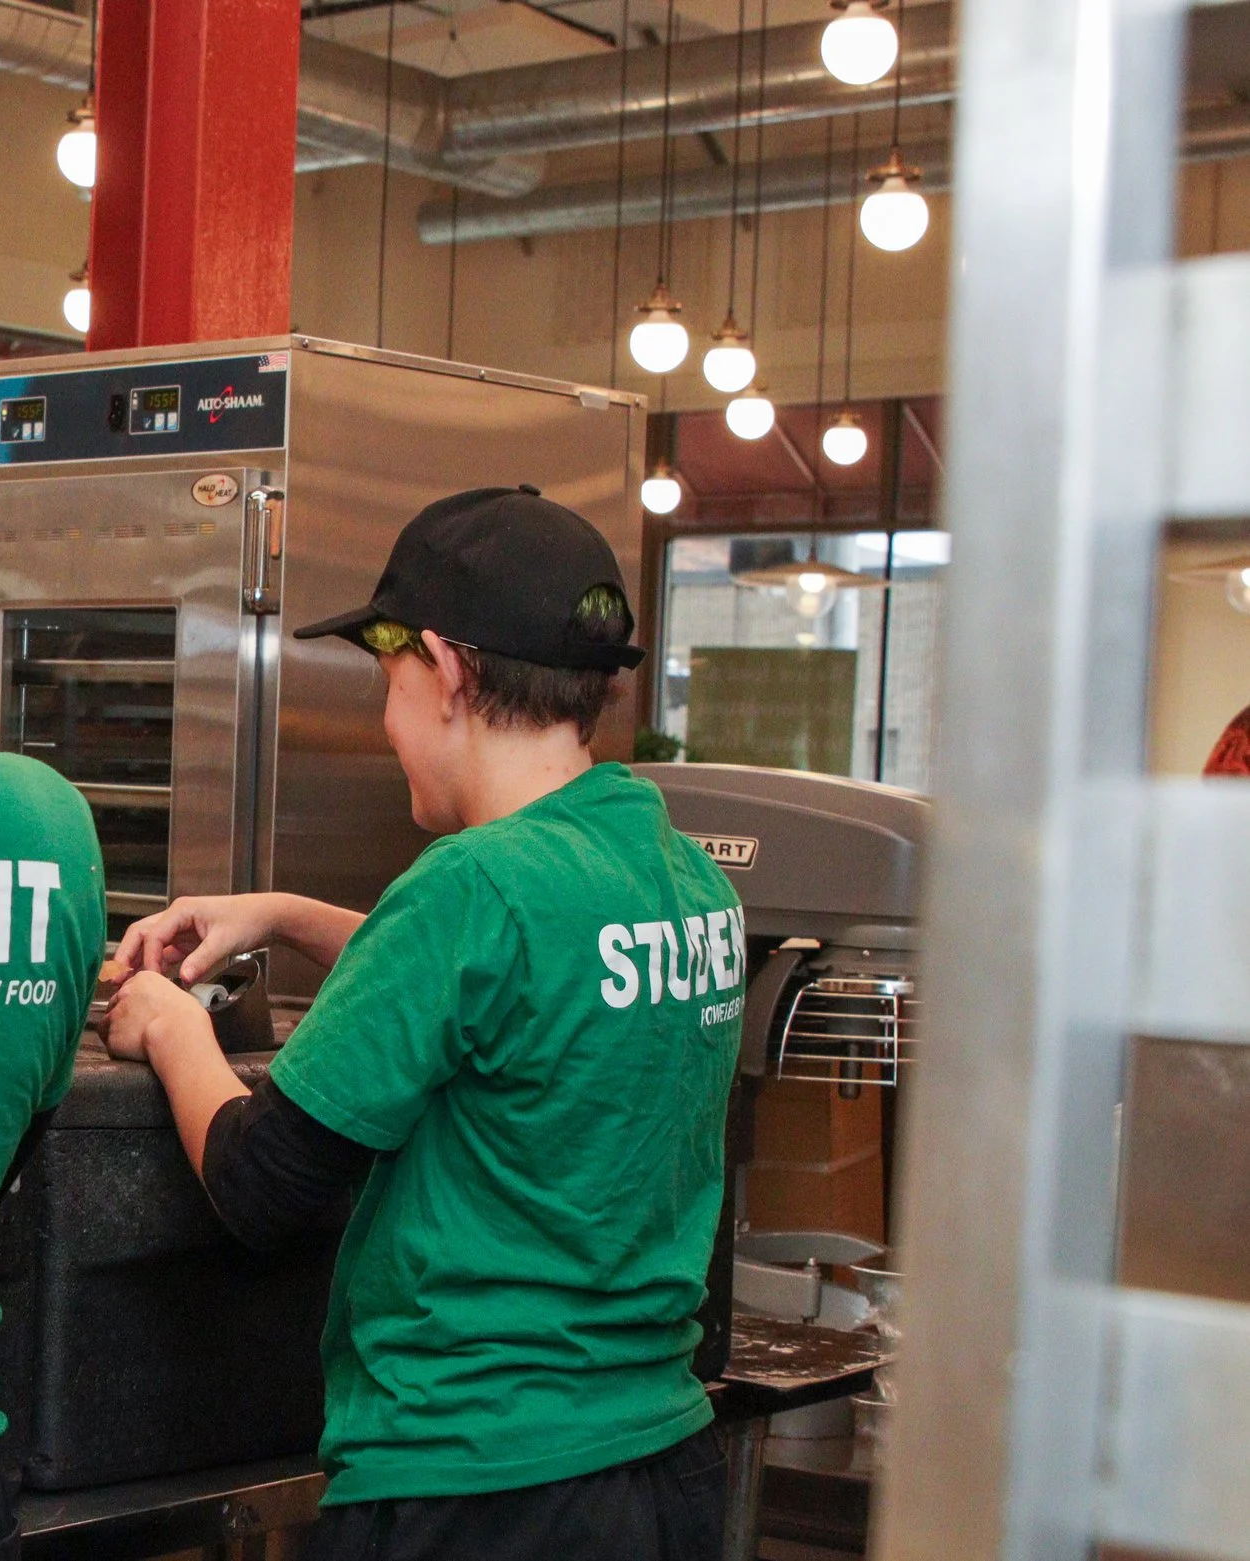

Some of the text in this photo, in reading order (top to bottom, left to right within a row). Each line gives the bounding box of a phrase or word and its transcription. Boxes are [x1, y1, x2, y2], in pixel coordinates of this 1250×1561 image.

[197, 394, 263, 411] ALTO-SHAAM
[197, 484, 233, 498] HALO HEAT
[696, 840, 747, 857] ART
[5, 979, 58, 1006] FOOD
